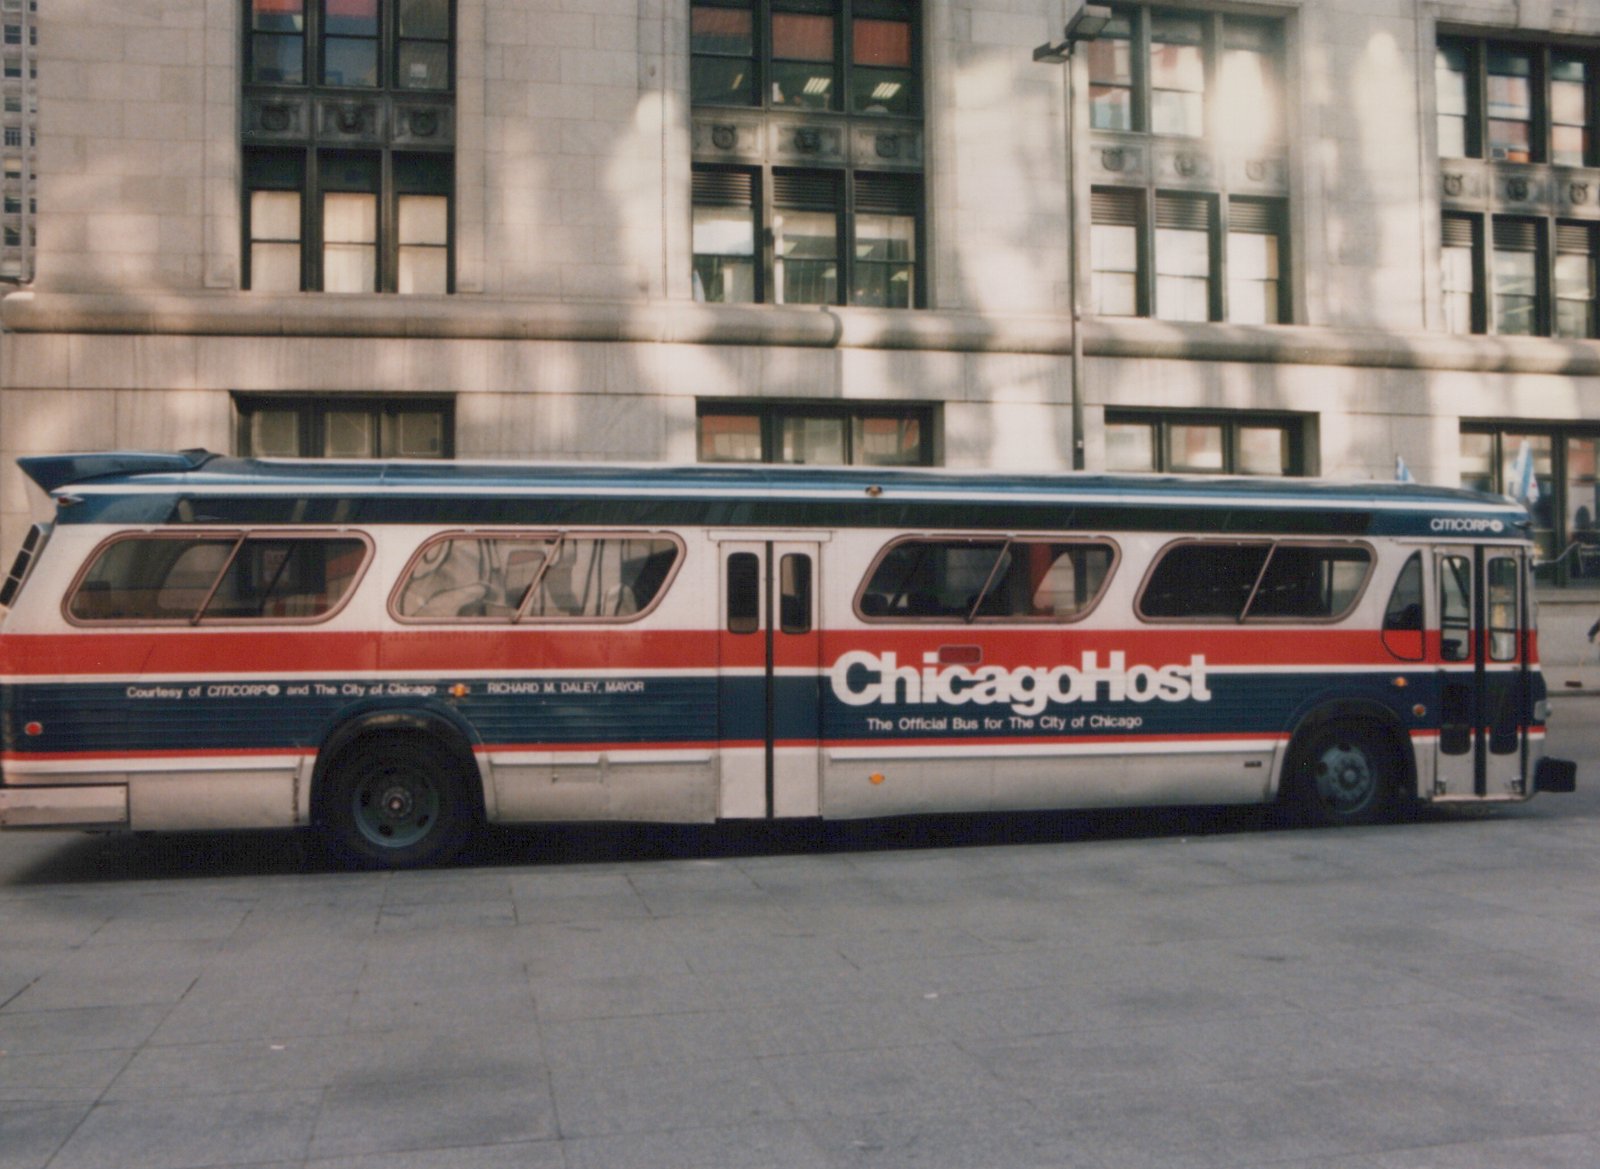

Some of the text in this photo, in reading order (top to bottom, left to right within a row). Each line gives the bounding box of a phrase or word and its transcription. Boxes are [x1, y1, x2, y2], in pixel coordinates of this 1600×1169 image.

[126, 686, 183, 699] Courtesy
[188, 685, 201, 697] of
[286, 684, 309, 695] and
[314, 684, 337, 695] The
[342, 684, 365, 696] City
[370, 684, 383, 695] of
[388, 683, 437, 696] Chicago
[487, 682, 539, 694] RICHARD
[605, 681, 645, 693] MAYOR
[831, 650, 1211, 716] ChicagoHost
[866, 715, 1143, 731] The Official Bus for The City of Chicago
